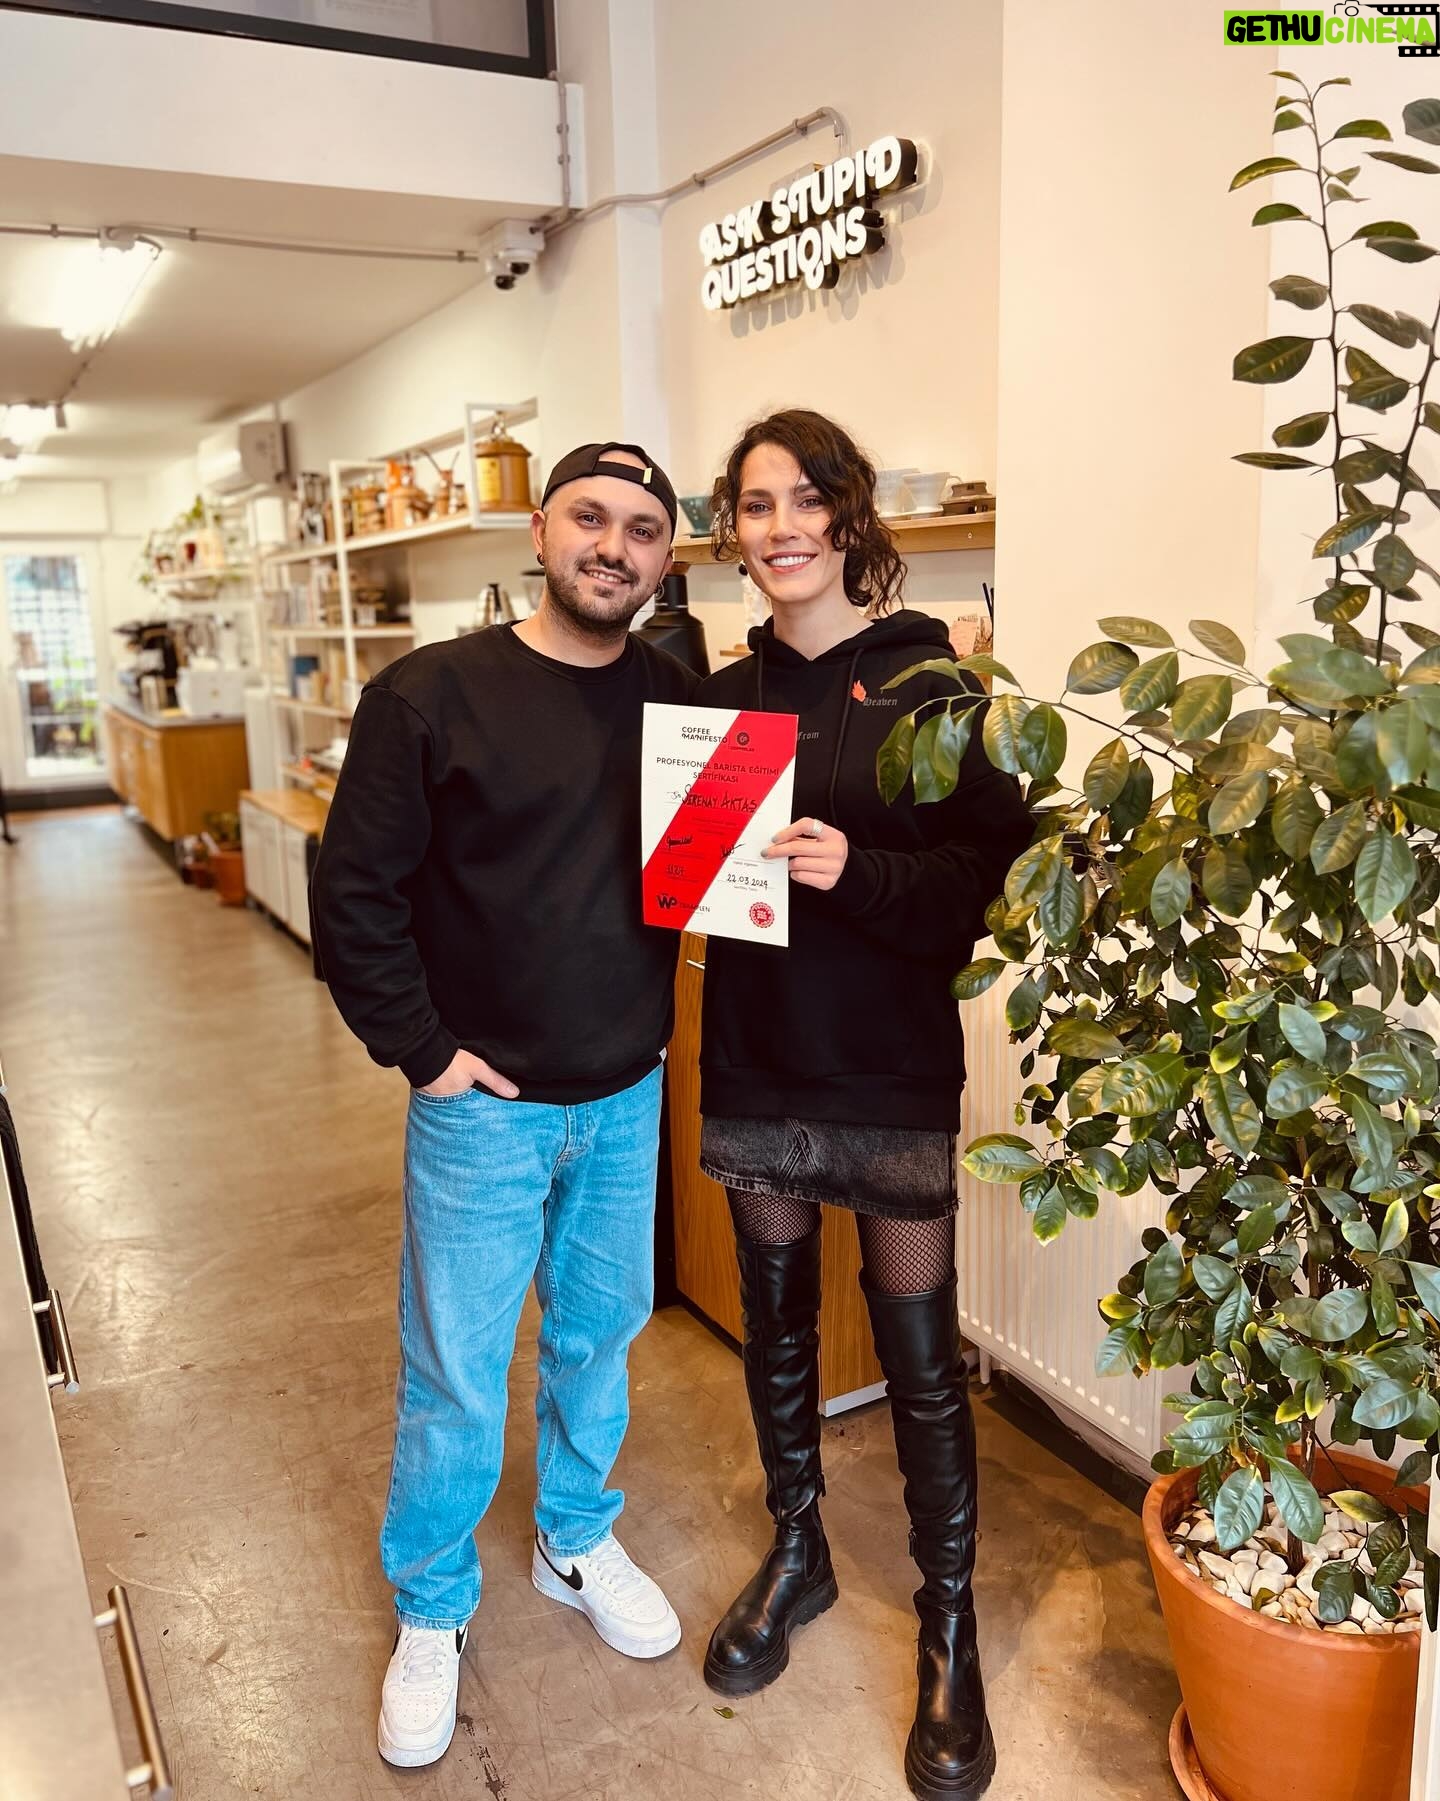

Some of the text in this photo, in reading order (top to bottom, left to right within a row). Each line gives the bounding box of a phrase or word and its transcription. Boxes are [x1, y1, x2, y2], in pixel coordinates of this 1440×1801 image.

[699, 135, 902, 266] ASK STUPID
[701, 206, 868, 310] QUESTIONS
[681, 726, 711, 735] COFFEE
[681, 733, 728, 744] MANIFESTO
[656, 757, 711, 769] PROFESYONEL
